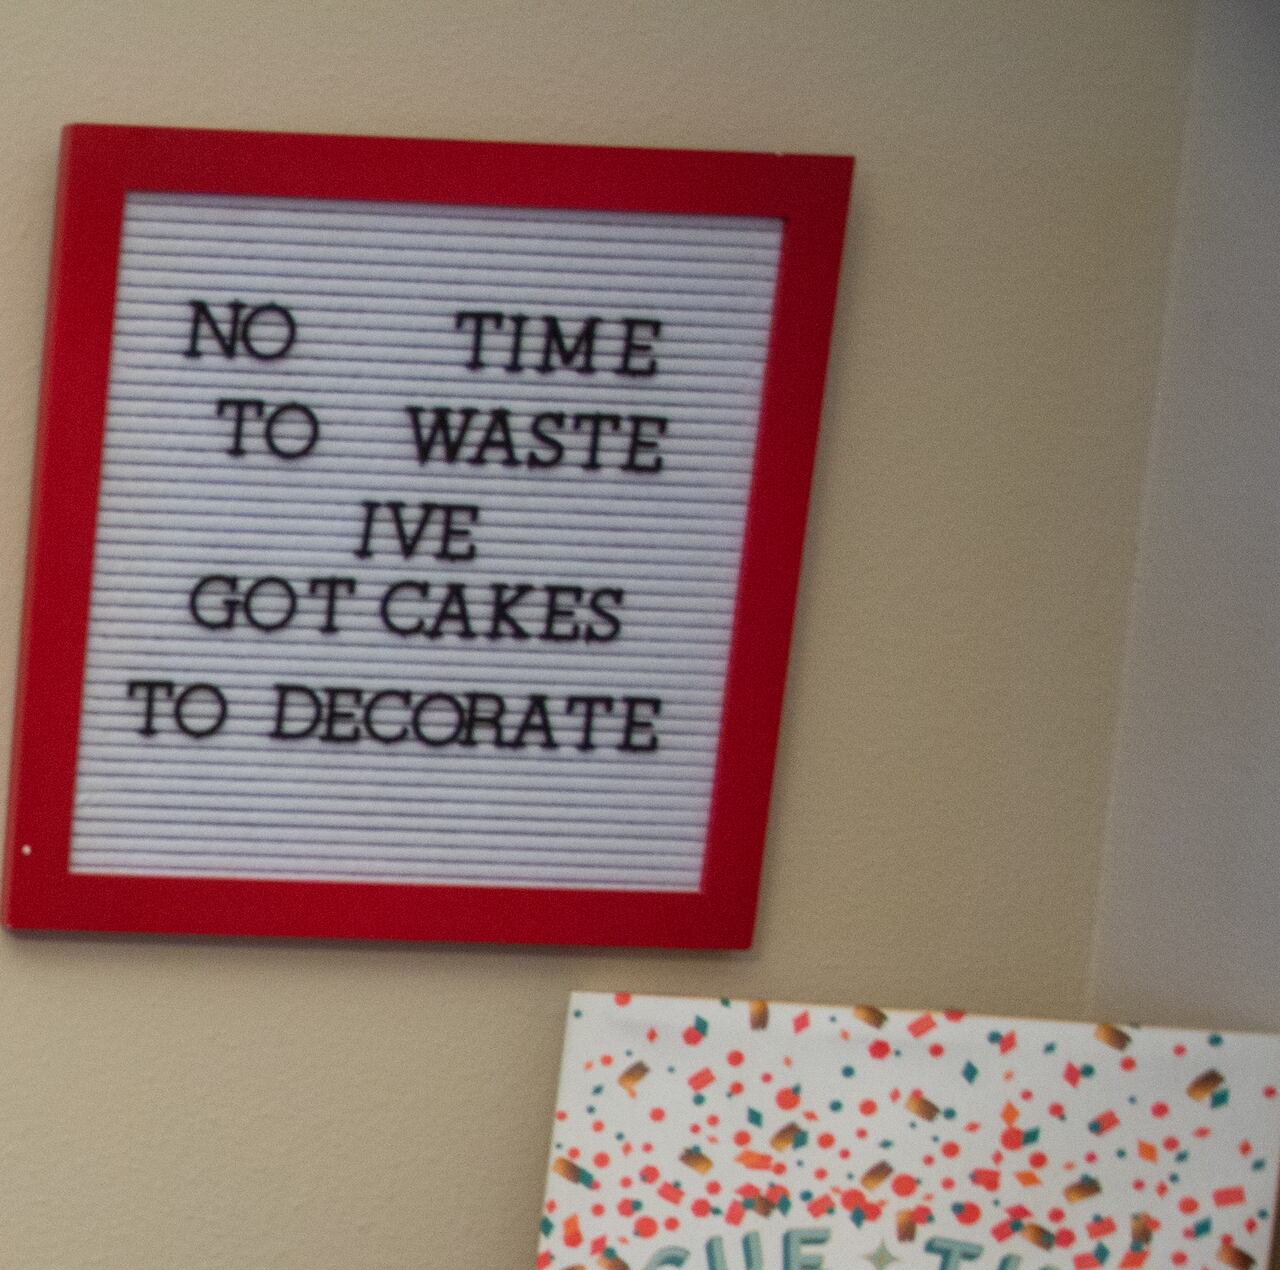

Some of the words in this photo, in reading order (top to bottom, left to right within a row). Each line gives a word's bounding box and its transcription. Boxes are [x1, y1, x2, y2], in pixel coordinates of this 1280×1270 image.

[182, 299, 298, 363] NO
[454, 309, 665, 379] TIME
[216, 397, 321, 462] TO
[402, 404, 670, 477] WASTE
[351, 500, 481, 564] IVE
[189, 573, 357, 635] GOT
[379, 580, 627, 647] CAKES
[126, 678, 229, 740] TO
[270, 682, 665, 756] DECORATE
